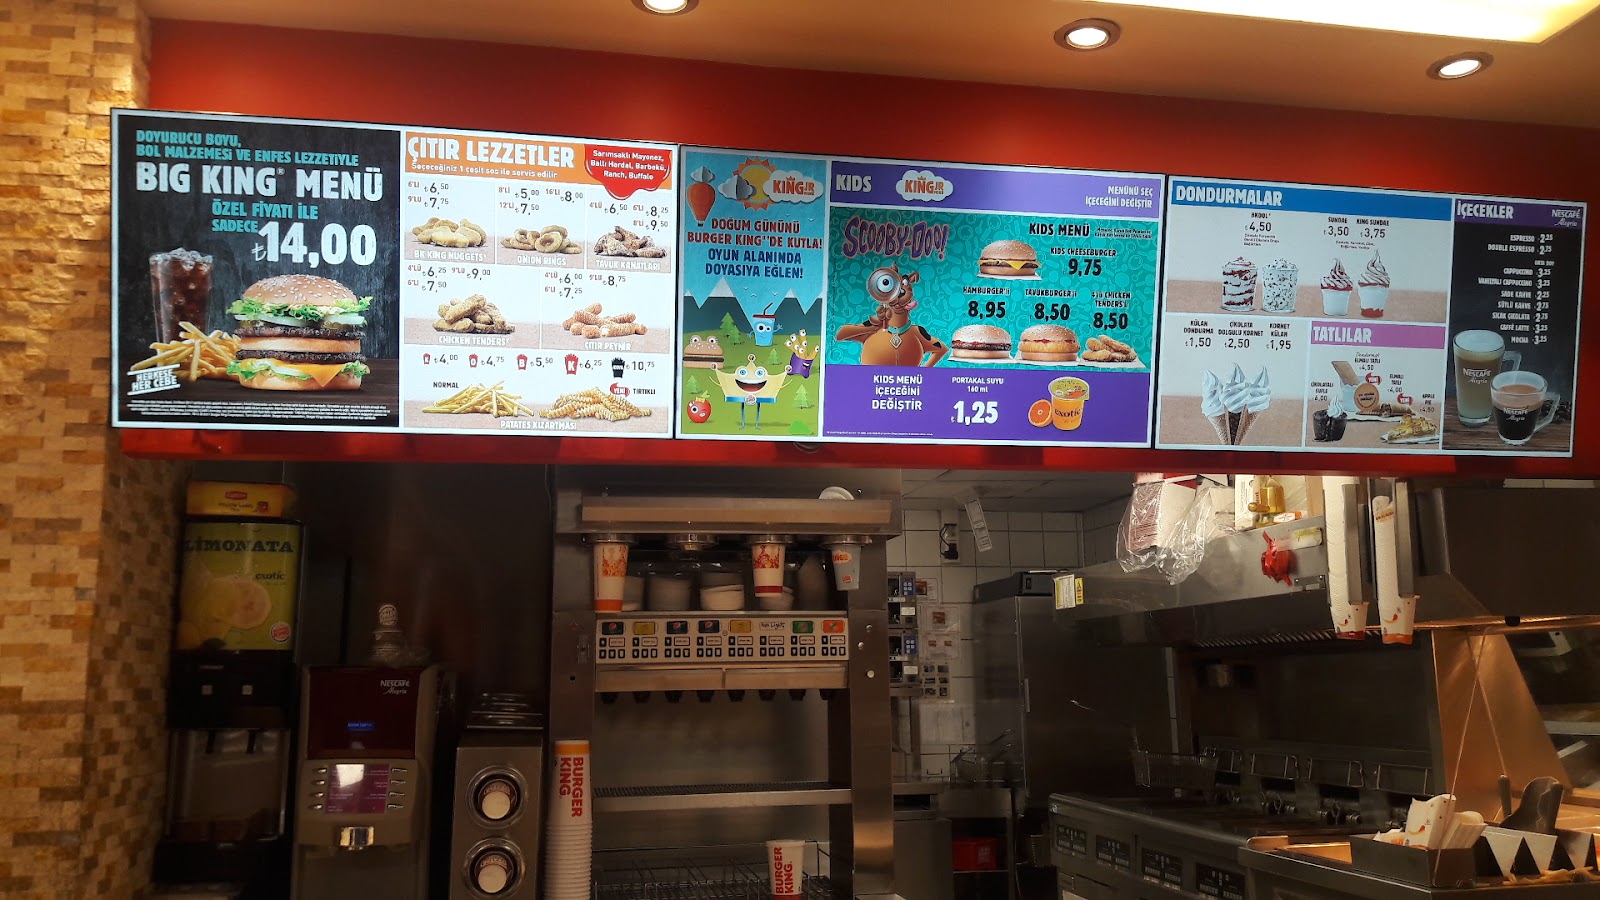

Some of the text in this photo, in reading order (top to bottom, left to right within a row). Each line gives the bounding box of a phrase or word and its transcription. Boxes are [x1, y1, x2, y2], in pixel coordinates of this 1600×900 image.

[136, 130, 241, 147] DOYURUCU BOYU,
[136, 145, 359, 167] BOL MALZEMESİ VE ENFES LEZZETİYLE
[408, 136, 575, 168] ÇITIR LEZZETLER
[632, 152, 664, 163] Mayonez,
[412, 162, 457, 173] Seçeceğiniz
[500, 168, 510, 176] ile
[511, 169, 535, 177] servis
[537, 170, 557, 178] edilir
[608, 161, 634, 170] Hardal,
[635, 162, 666, 172] Barbekü,
[136, 162, 191, 193] BIG
[296, 166, 383, 201] MENÜ
[603, 170, 653, 180] Ranch, Buffalo
[773, 180, 804, 195] KING
[836, 174, 871, 192] KIDS
[904, 179, 934, 194] KING
[1108, 185, 1153, 197] MENÜNÜ SEÇ
[1176, 185, 1282, 207] DONDURMALAR
[212, 198, 318, 220] ÖZEL FİYATI İLE
[1457, 200, 1514, 219] İÇECEKLER
[212, 219, 258, 233] SADECE
[712, 217, 800, 234] DOĞUM GÜNÜNÜ
[1029, 223, 1054, 235] KIDS
[1058, 223, 1090, 237] MENÜ
[688, 232, 822, 248] BURGER KUTLA!
[426, 251, 447, 260] KING
[708, 248, 802, 264] OYUN ALANINDA
[1050, 247, 1117, 257] KIDS CHEESEBURGER
[1509, 245, 1534, 253] ESPRESSO
[517, 255, 566, 266] ONION RINGS
[595, 259, 660, 271] TAVUK KANATLARI
[706, 263, 803, 278] DOYASIYA EĞLEN!
[438, 336, 470, 344] CHICKEN
[1313, 326, 1372, 343] TATLILAR
[567, 360, 576, 371] K
[136, 368, 173, 381] HERKESE
[873, 374, 923, 384] KIDS MENÜ
[952, 377, 985, 385] PORTAKAL
[131, 375, 178, 391] HER CEBE
[433, 381, 459, 389] NORMAL
[876, 384, 920, 397] İÇECEĞİNİ
[872, 398, 922, 412] DEĞİŞTİR
[1054, 407, 1081, 418] exotic
[500, 420, 576, 430] PATATES KIZARTMASI
[380, 679, 410, 687] NESCAFÉ
[559, 757, 571, 796] KING
[571, 757, 584, 817] BURGER
[774, 847, 784, 894] BURGER
